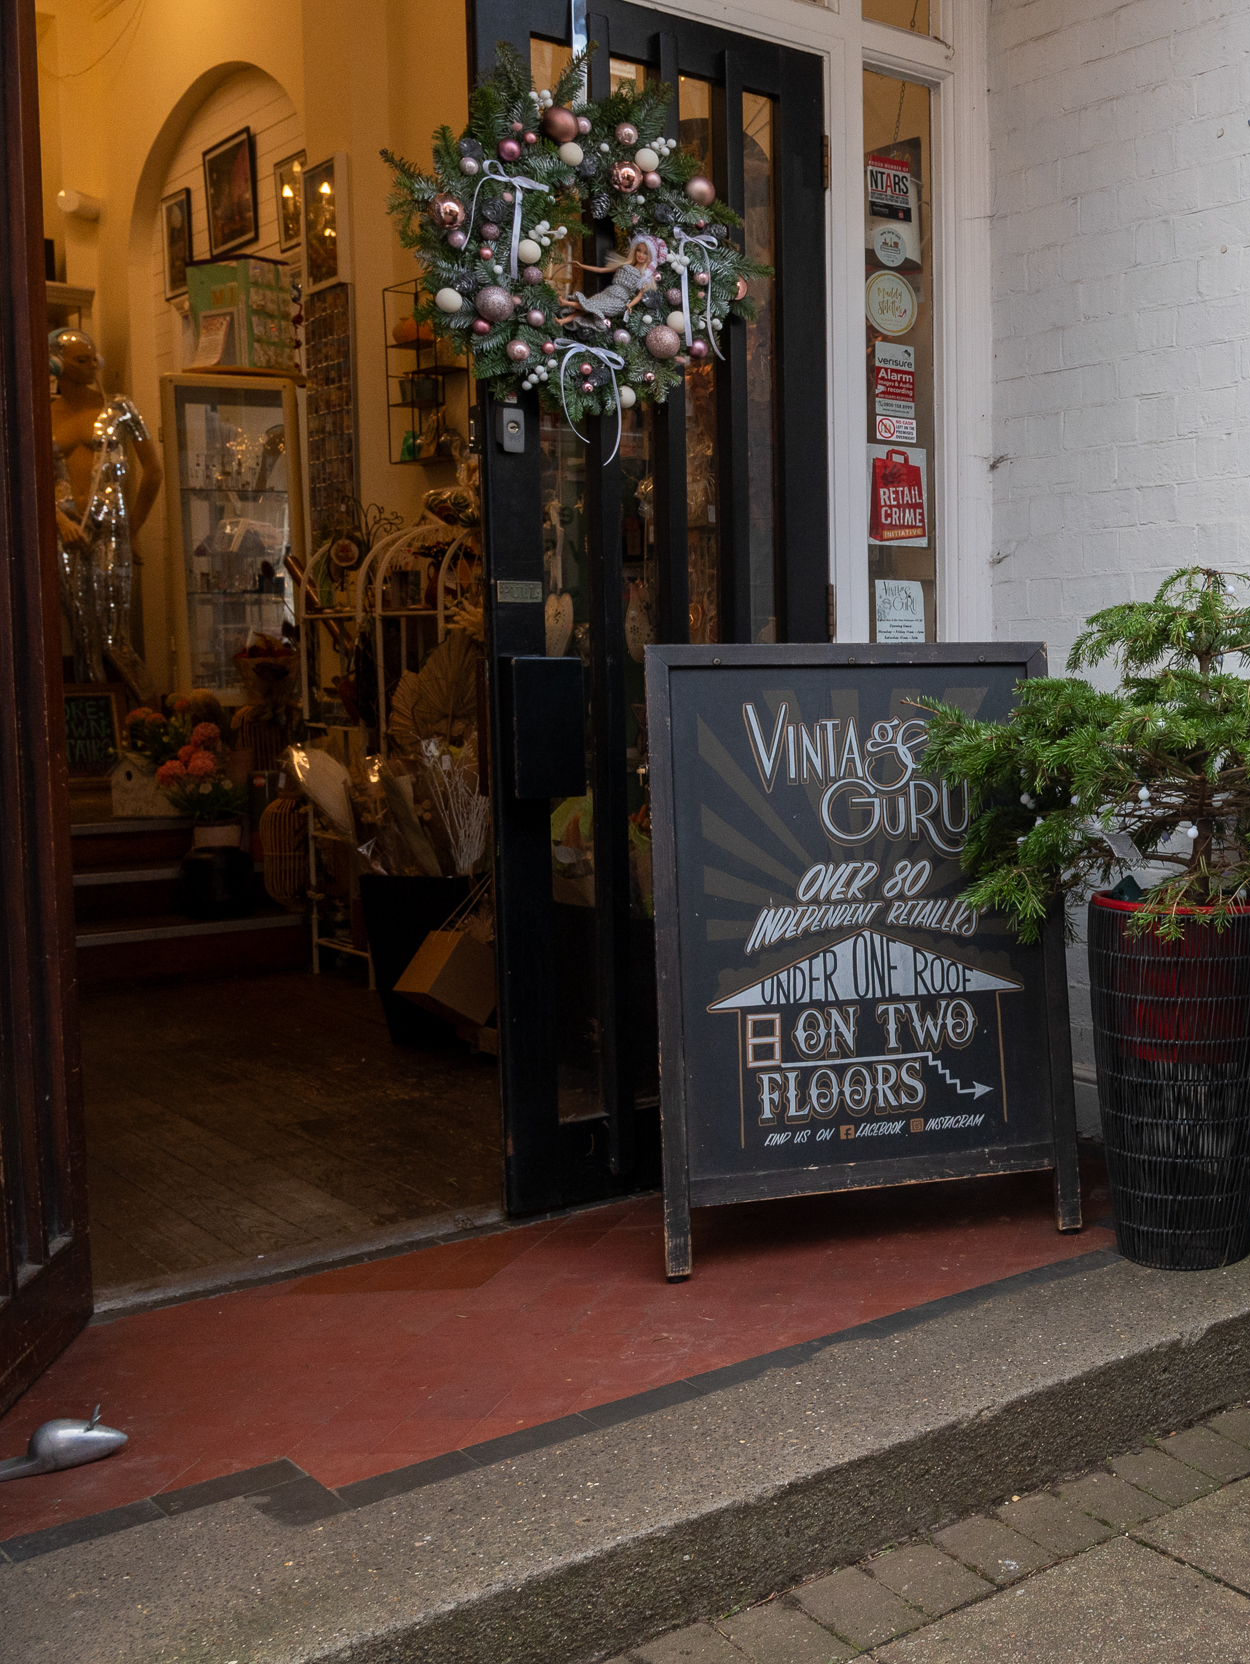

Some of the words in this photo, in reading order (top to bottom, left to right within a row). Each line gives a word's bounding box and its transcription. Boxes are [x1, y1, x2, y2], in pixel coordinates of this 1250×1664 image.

[870, 170, 909, 196] NTARS
[877, 287, 902, 303] Muddy
[877, 357, 913, 368] verisure
[878, 368, 913, 383] Alarm
[878, 379, 894, 387] Images
[887, 387, 913, 396] recording
[879, 486, 923, 506] RETAIL
[881, 507, 923, 526] CRIME
[884, 528, 922, 538] INITIATIVE
[820, 778, 971, 859] GURU
[796, 860, 880, 903] OVER
[882, 859, 933, 899] 80
[745, 901, 885, 955] INDEPENDENT
[760, 948, 838, 1004] UNDER
[852, 931, 902, 999] ONE
[914, 948, 975, 995] ROOF
[792, 1005, 860, 1060] ON
[877, 998, 978, 1053] TWO
[757, 1060, 926, 1126] FLOORS
[764, 1132, 792, 1146] FIND
[794, 1130, 811, 1144] US
[816, 1128, 835, 1142] ON
[856, 1120, 906, 1137] FACEBOOK
[925, 1114, 985, 1131] INSTAGRAM
